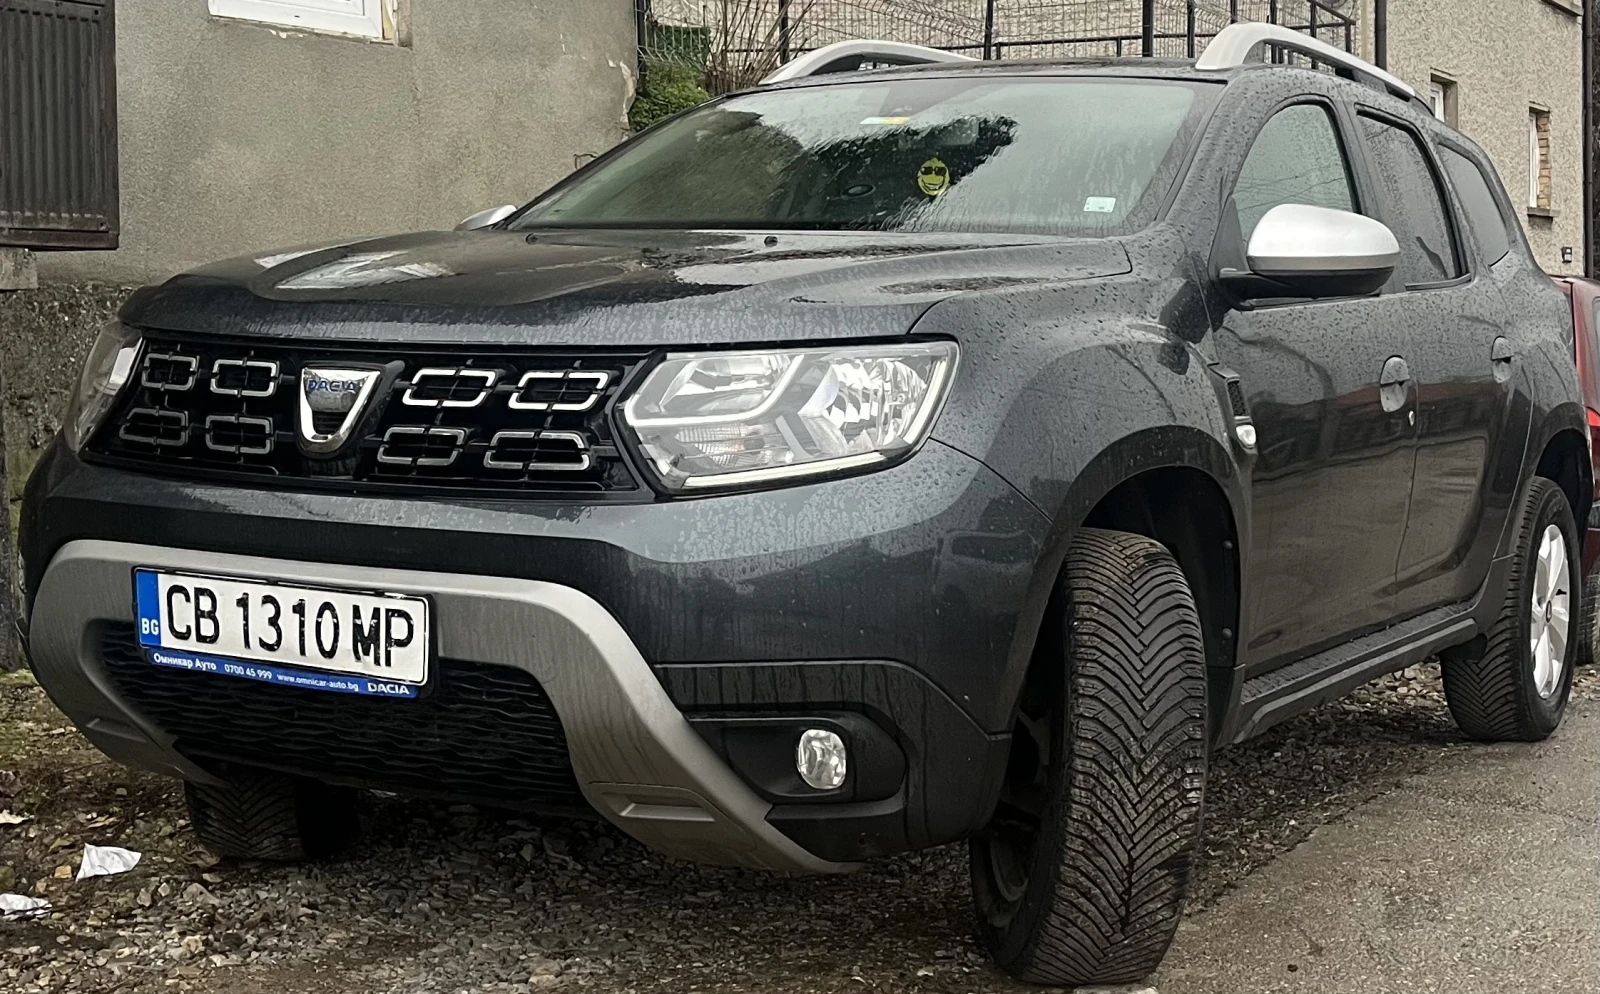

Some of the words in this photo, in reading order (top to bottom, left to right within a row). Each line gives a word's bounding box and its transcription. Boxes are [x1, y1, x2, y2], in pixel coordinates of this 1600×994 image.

[307, 379, 356, 393] DACIA
[141, 617, 160, 635] BG
[166, 584, 220, 644] CB
[236, 592, 340, 659] 1310
[352, 604, 415, 668] MP
[153, 653, 193, 669] Омникар
[195, 658, 217, 671] Ауто
[224, 664, 244, 675] 0700
[246, 667, 256, 677] 45
[257, 670, 273, 680] 999
[276, 673, 359, 692] www.omnicar-auto.bg
[367, 682, 410, 695] DACIA
